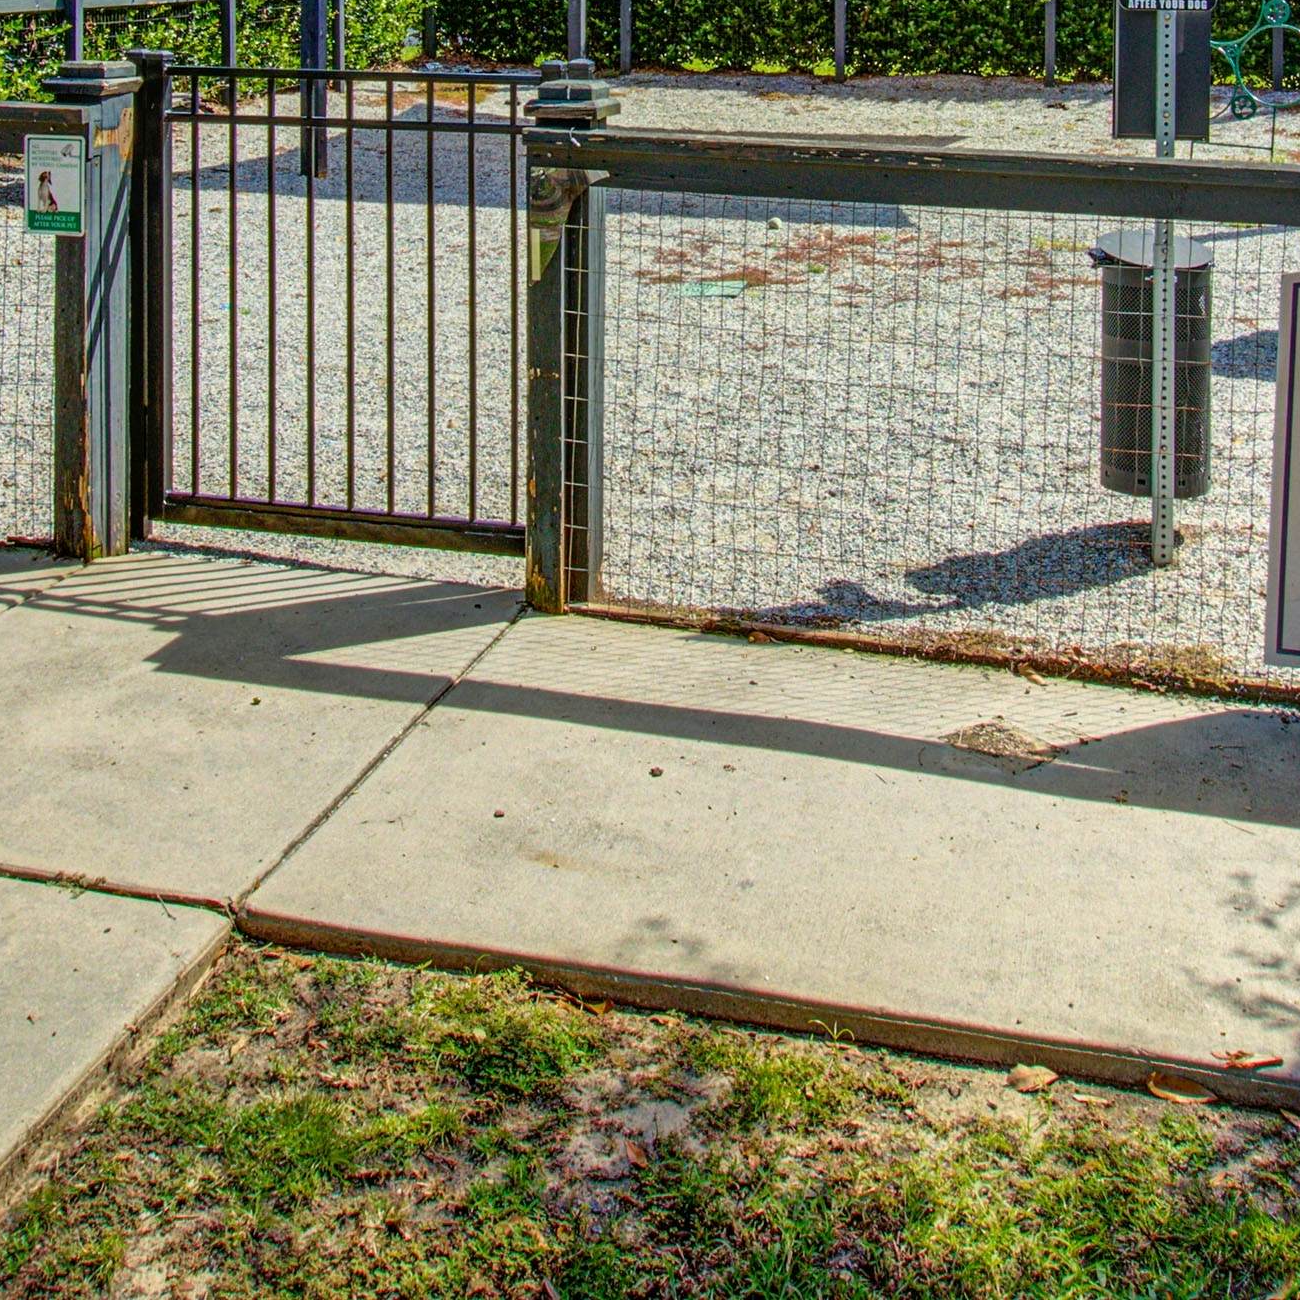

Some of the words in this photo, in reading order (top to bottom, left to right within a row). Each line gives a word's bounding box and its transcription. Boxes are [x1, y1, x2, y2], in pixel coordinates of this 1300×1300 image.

[1128, 0, 1156, 8] AFTER
[1159, 0, 1185, 9] YOUR
[1188, 0, 1208, 10] DOG
